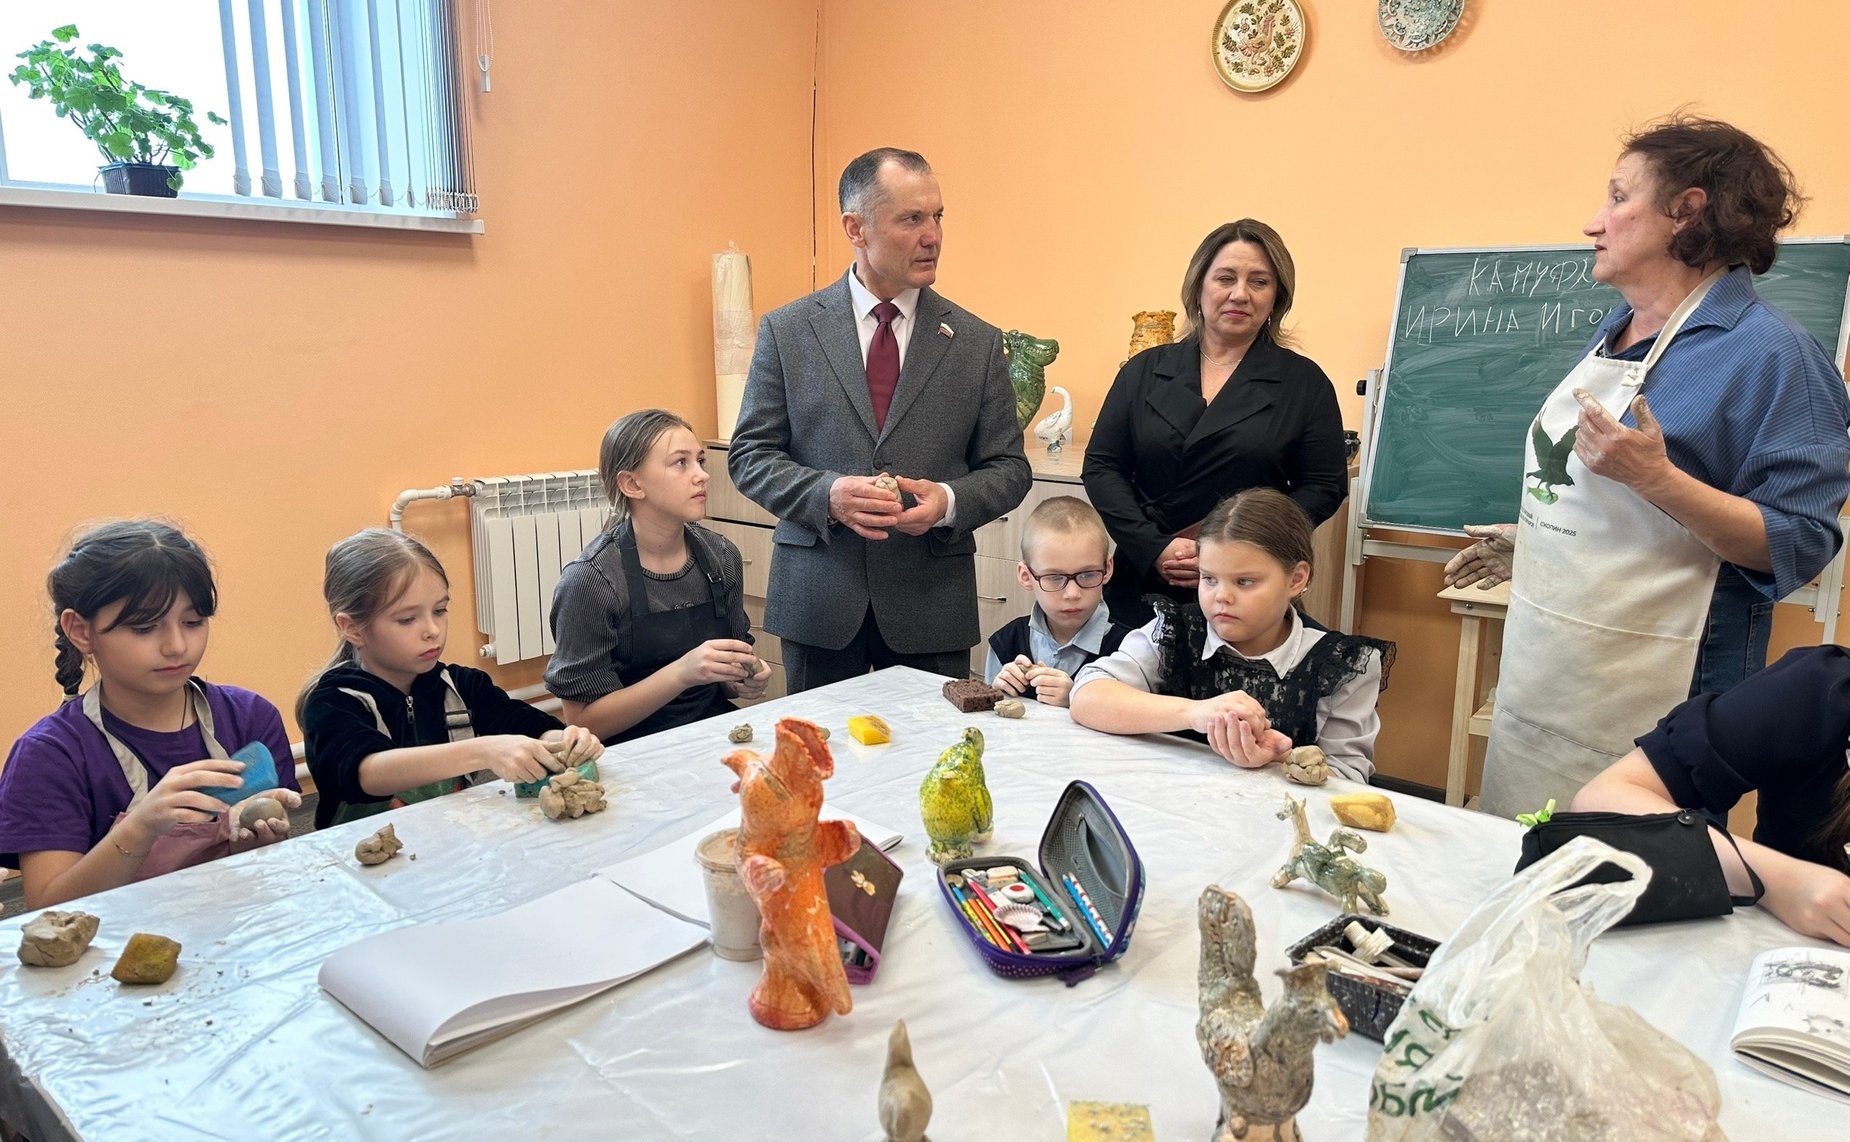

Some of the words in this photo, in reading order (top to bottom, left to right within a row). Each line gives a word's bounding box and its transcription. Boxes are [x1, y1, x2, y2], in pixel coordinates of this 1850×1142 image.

[1405, 304, 1520, 345] ИРИНА
[1539, 521, 1561, 533] СКОПИН
[1562, 528, 1577, 537] 2025
